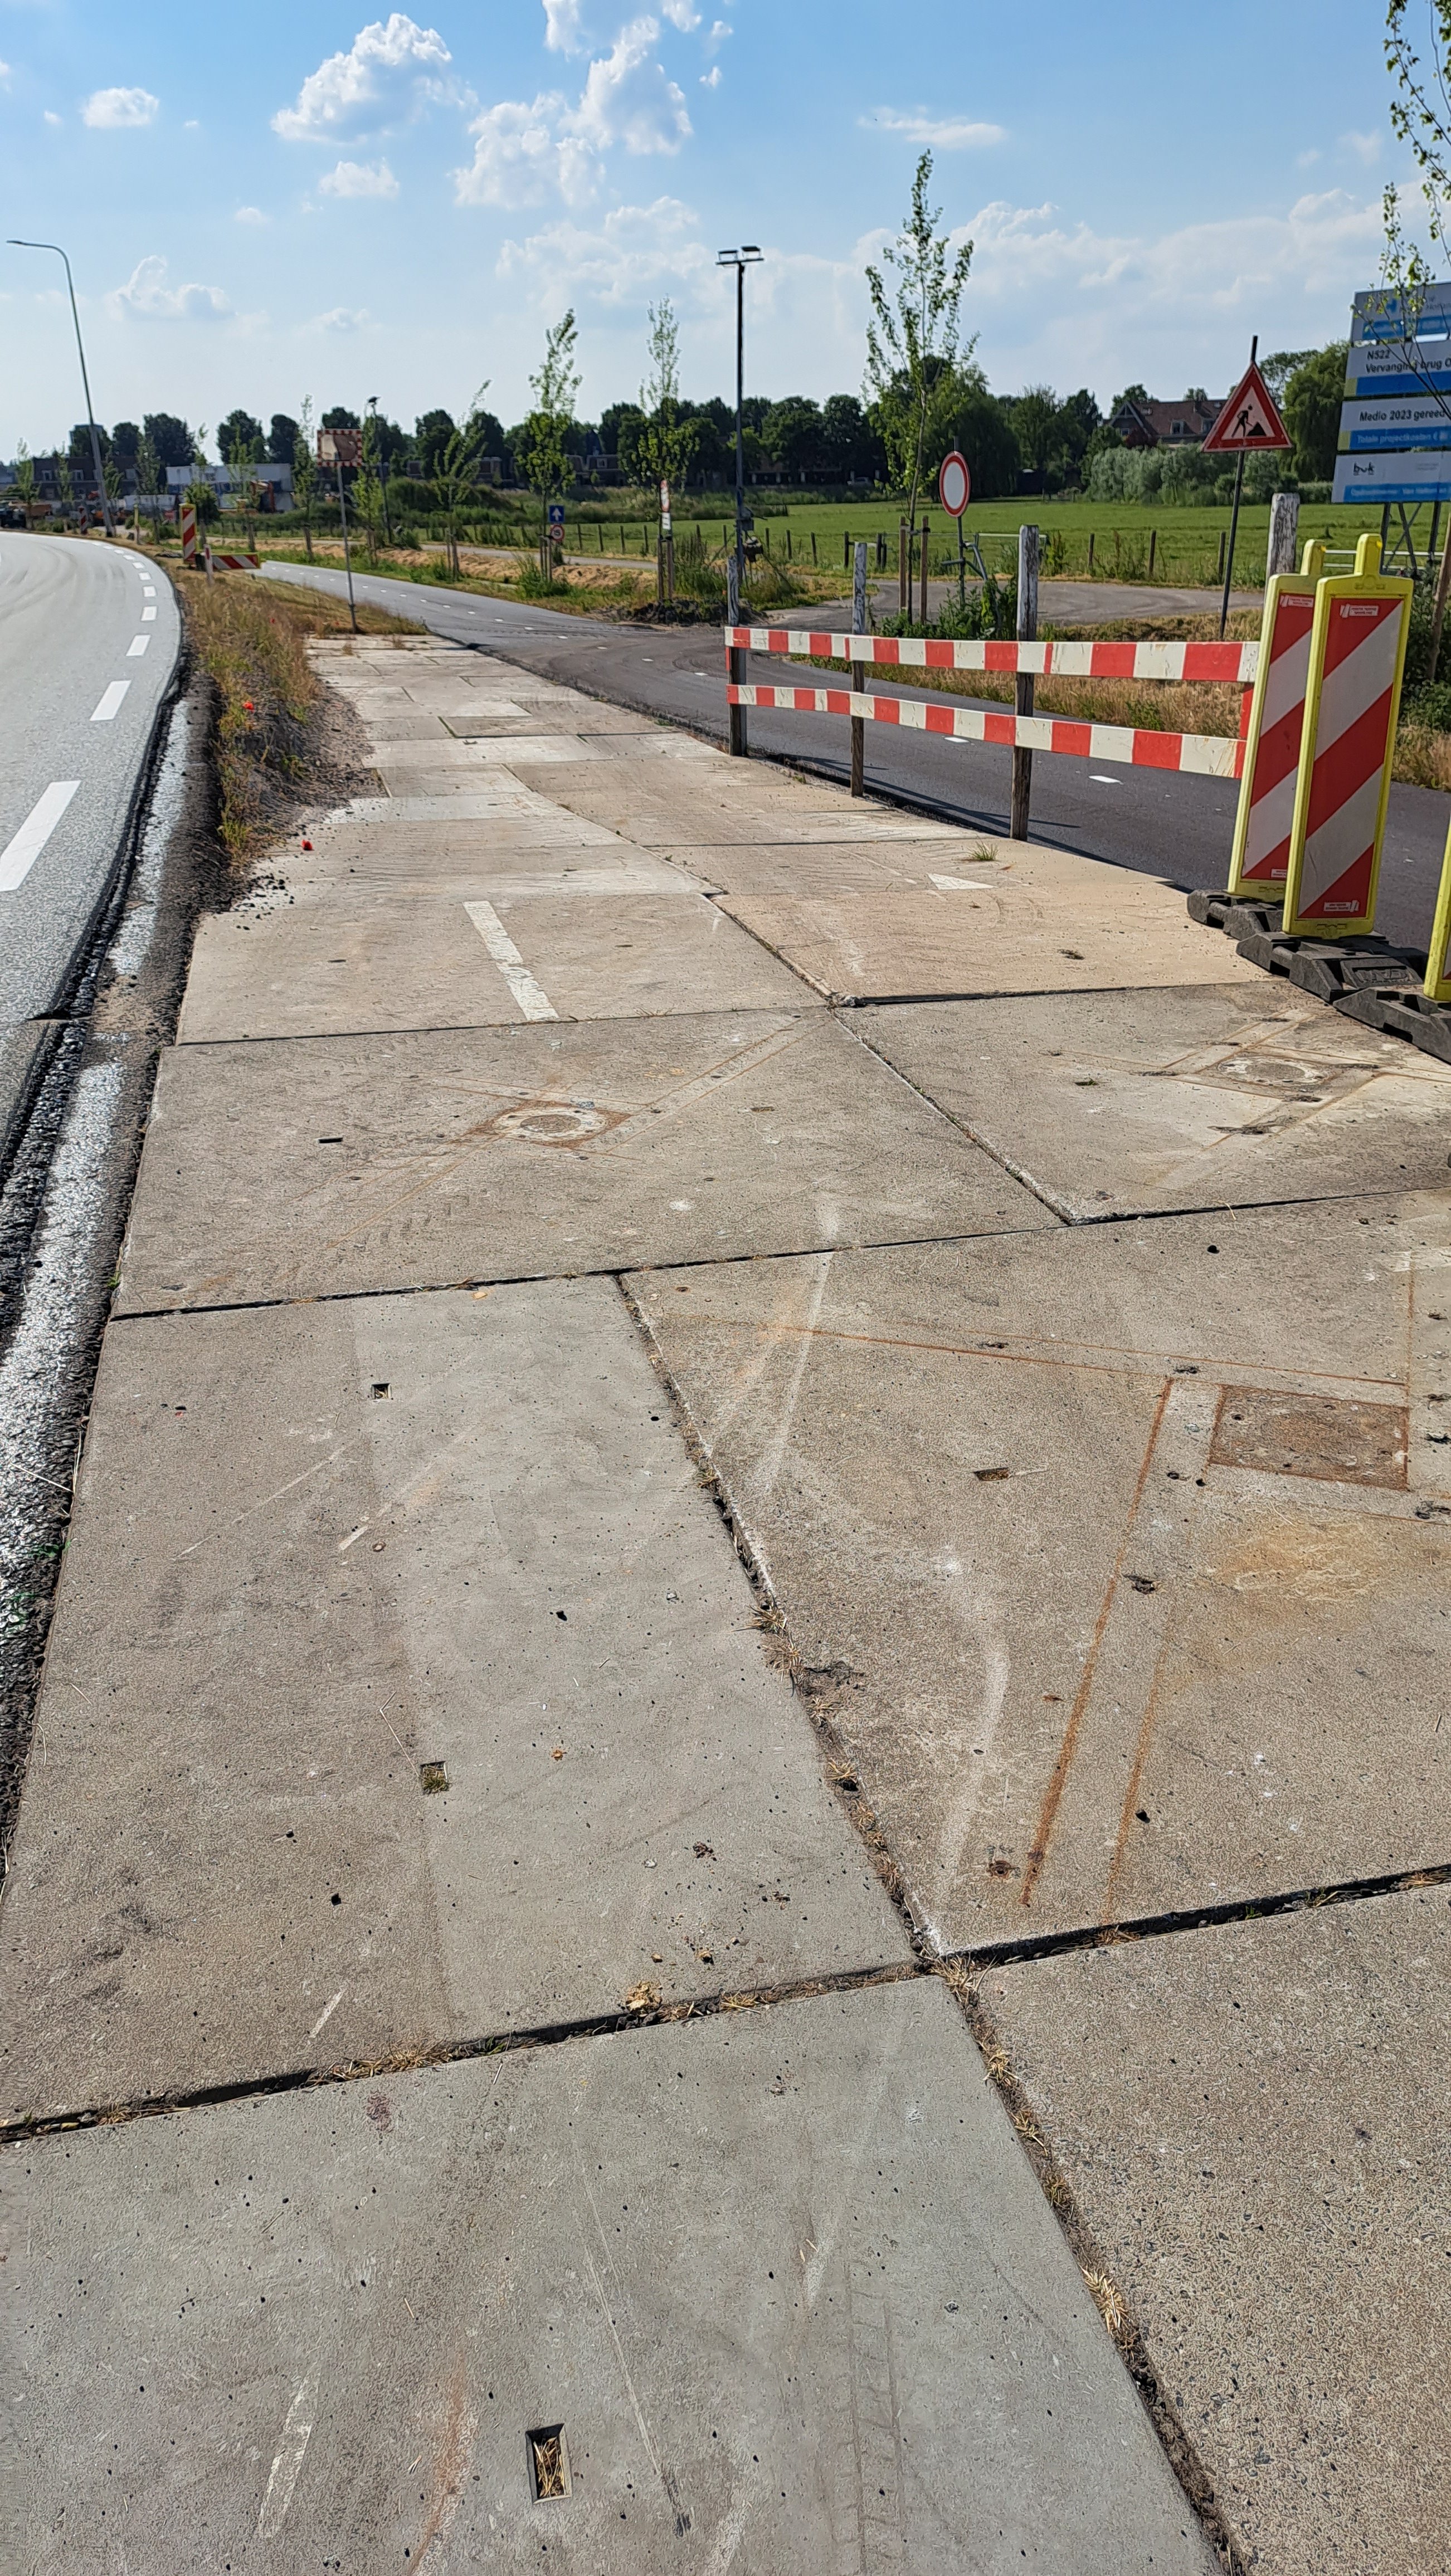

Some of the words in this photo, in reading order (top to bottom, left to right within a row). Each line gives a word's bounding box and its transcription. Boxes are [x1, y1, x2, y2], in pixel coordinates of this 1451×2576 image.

[1367, 349, 1390, 360] N522
[1366, 362, 1418, 374] Vervangin
[1360, 411, 1387, 422] Medio
[1390, 409, 1412, 421] 2023
